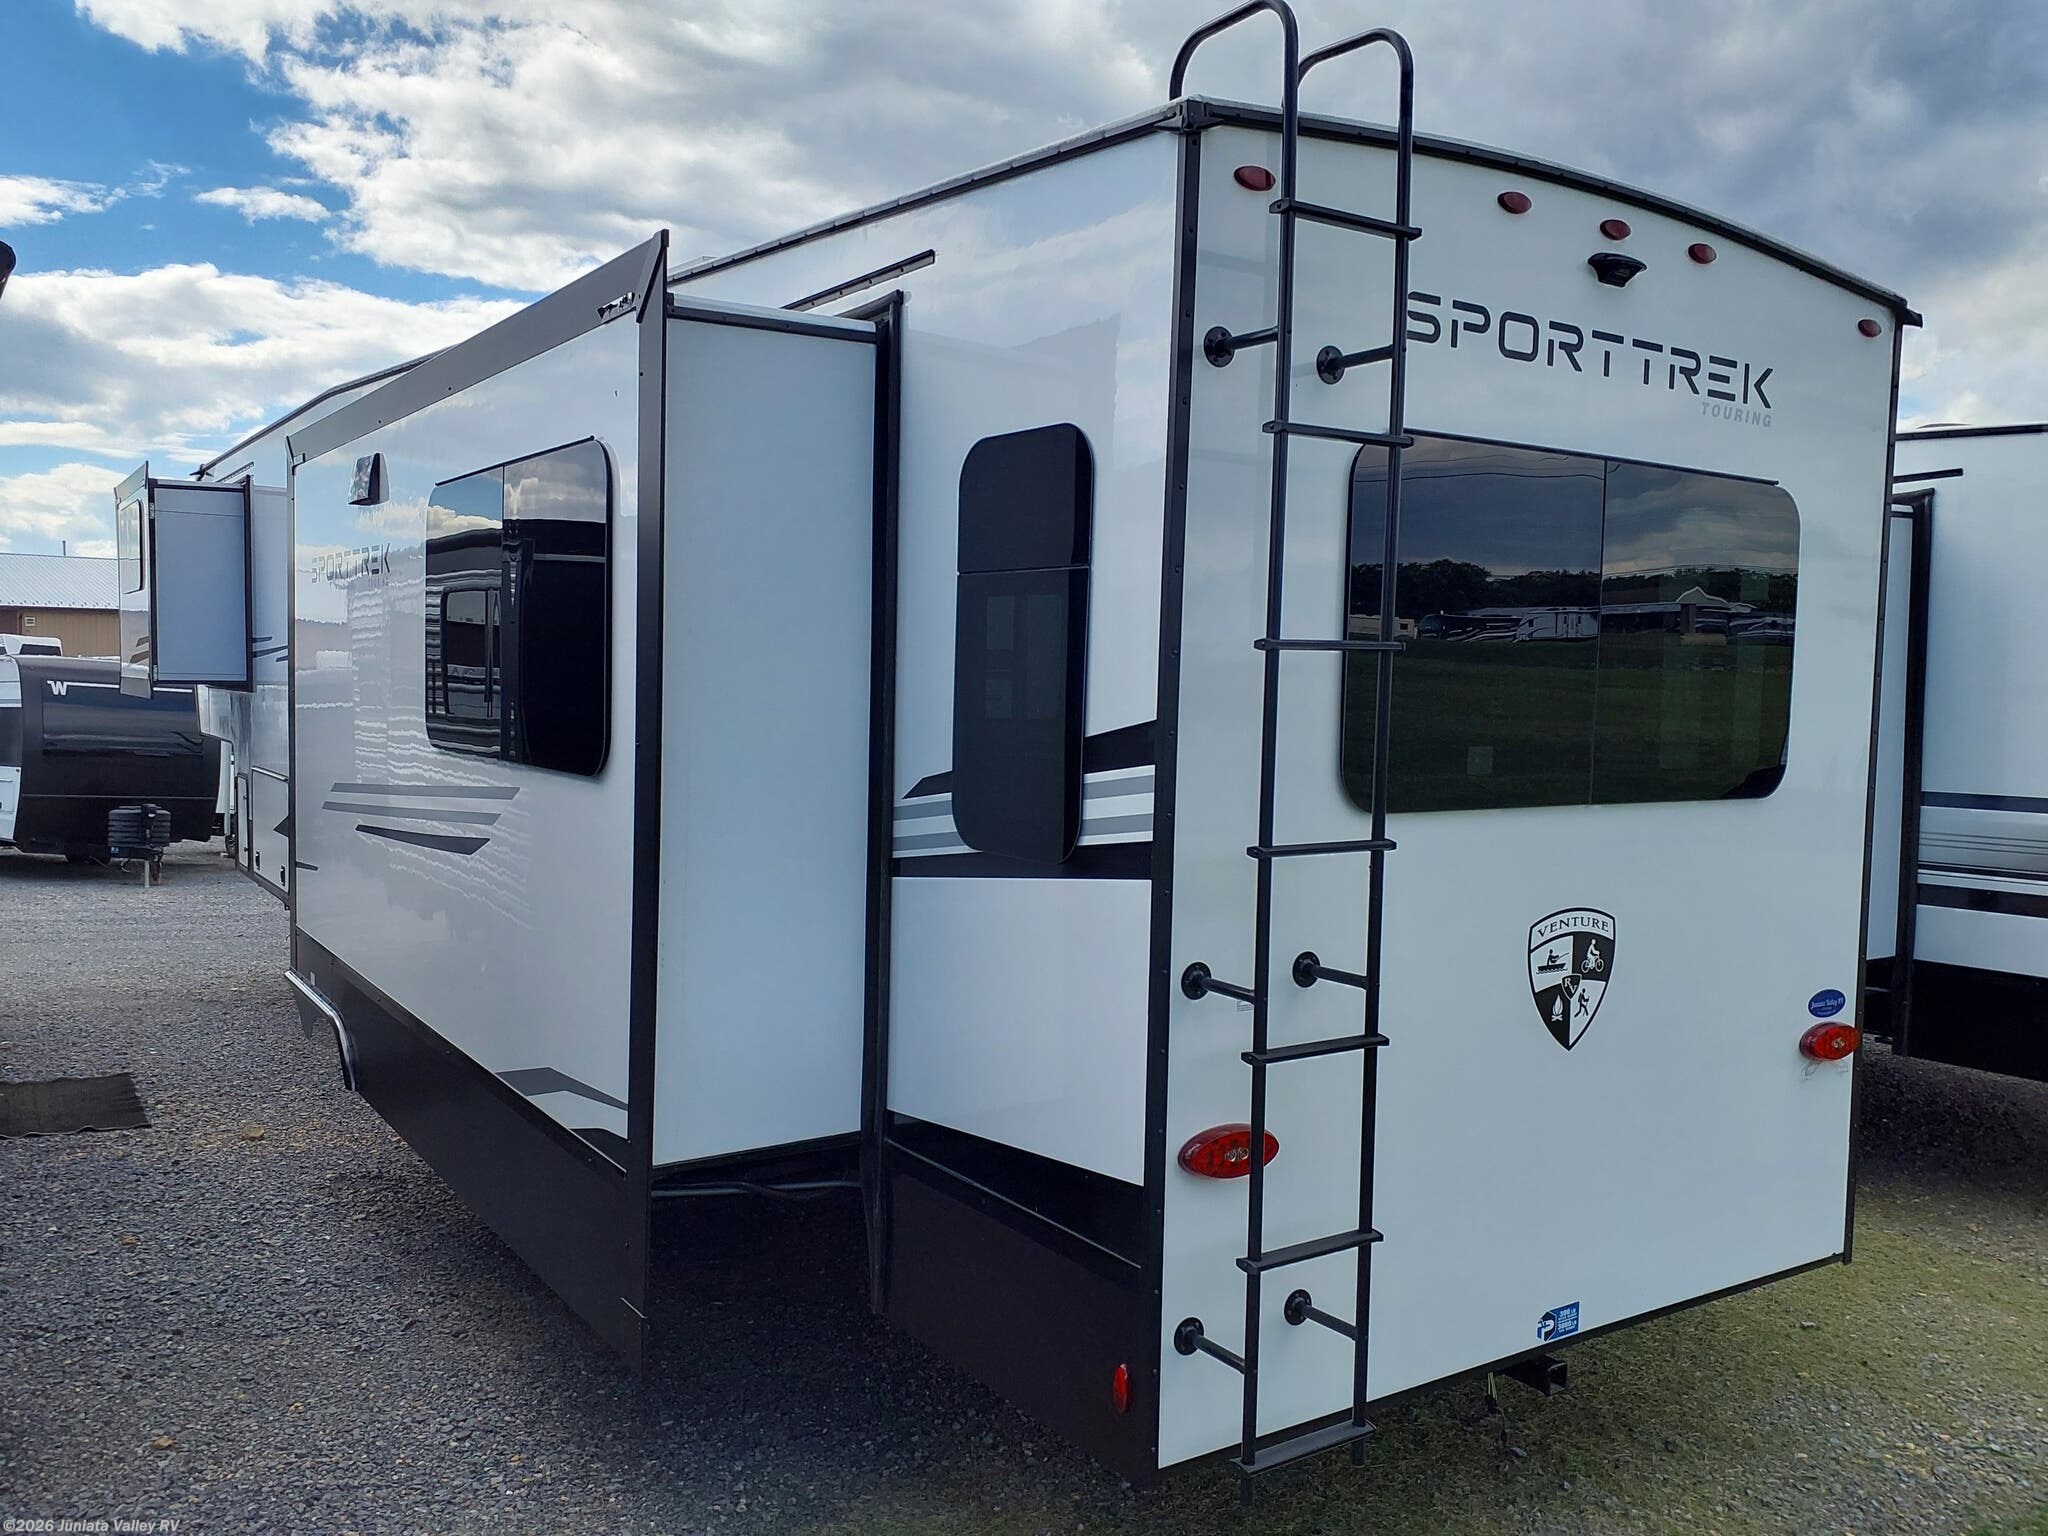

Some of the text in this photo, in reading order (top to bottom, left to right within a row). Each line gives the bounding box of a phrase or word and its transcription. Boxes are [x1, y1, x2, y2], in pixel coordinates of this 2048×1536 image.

[1406, 290, 1773, 409] SPORTTREK
[1702, 402, 1772, 427] TOURING
[311, 543, 391, 584] SPORTTREK
[1537, 916, 1609, 937] VENTURE
